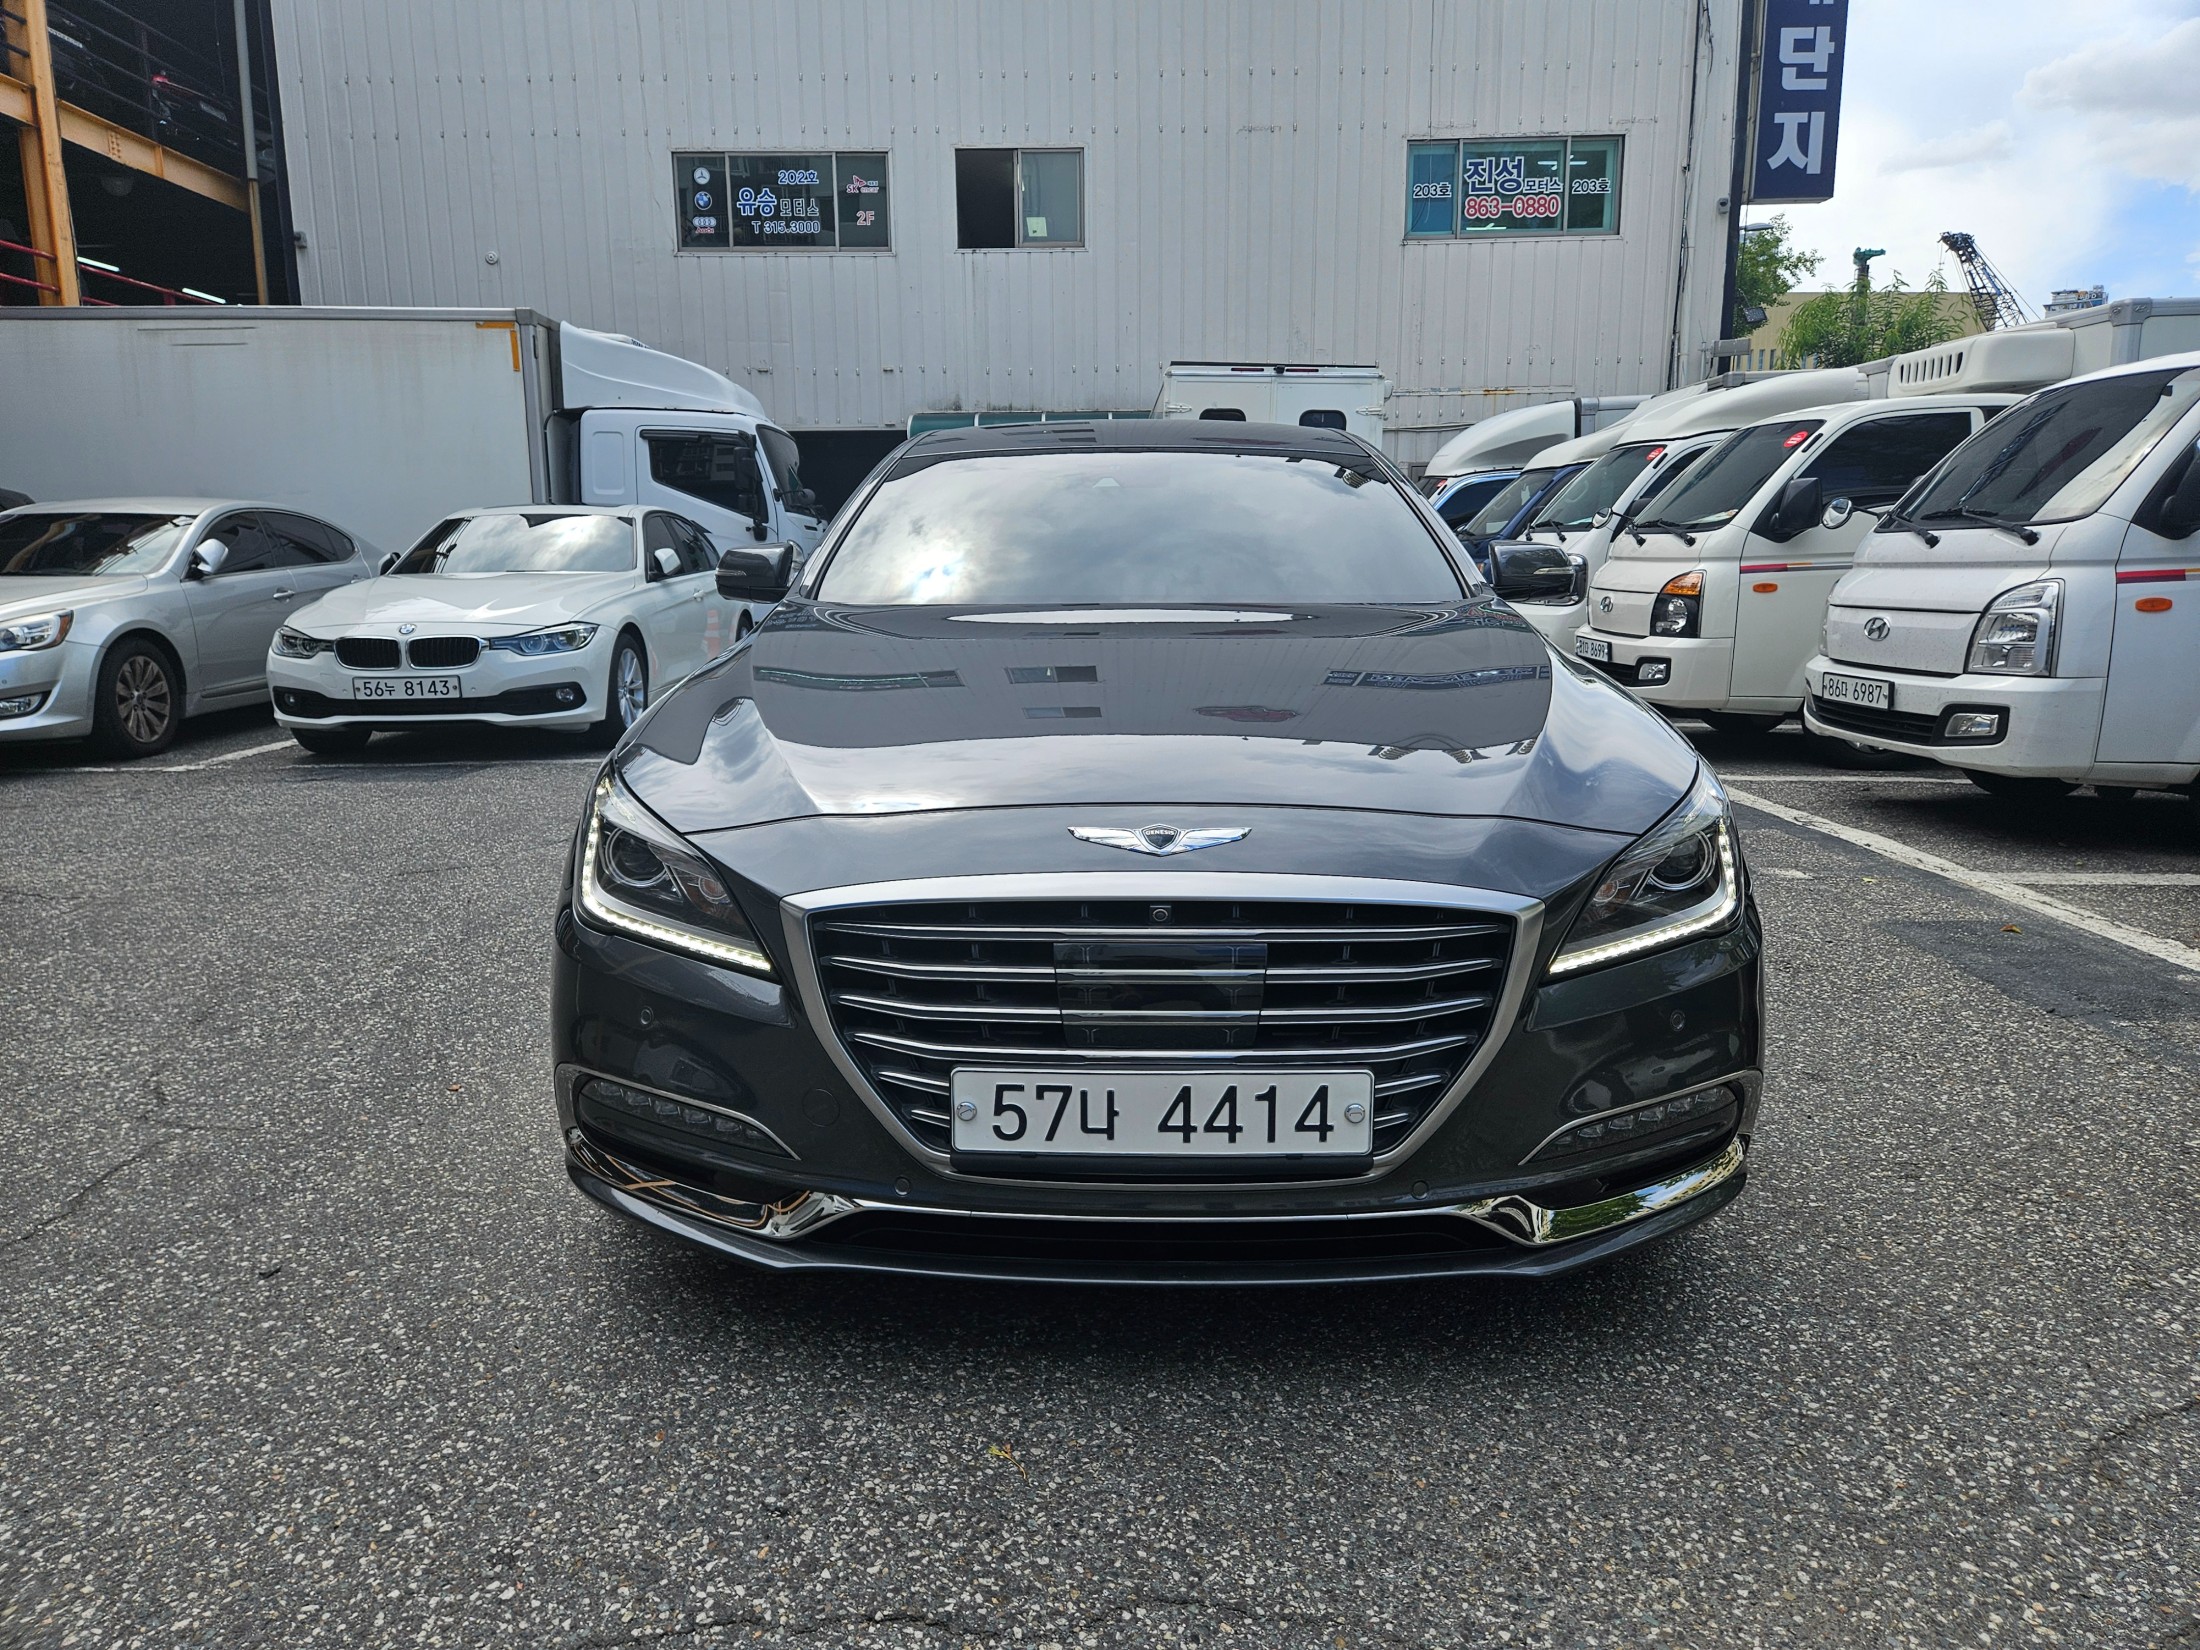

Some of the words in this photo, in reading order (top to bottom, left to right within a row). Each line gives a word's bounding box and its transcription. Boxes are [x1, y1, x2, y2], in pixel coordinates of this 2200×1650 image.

[1767, 0, 1835, 174] 단지
[778, 170, 819, 185] 202호
[1464, 156, 1524, 194] 진성
[1523, 177, 1563, 193] 모터스
[1413, 182, 1452, 198] 203호
[1572, 178, 1611, 194] 203호
[737, 187, 777, 216] 유승
[780, 198, 819, 216] 모터스
[1465, 195, 1560, 219] 863-0880
[752, 221, 761, 234] T
[856, 211, 875, 225] 2F
[363, 681, 395, 697] 56누
[404, 680, 450, 696] 8143
[1853, 682, 1882, 704] 6987
[992, 1084, 1119, 1141] 57나
[1157, 1085, 1335, 1143] 4414
